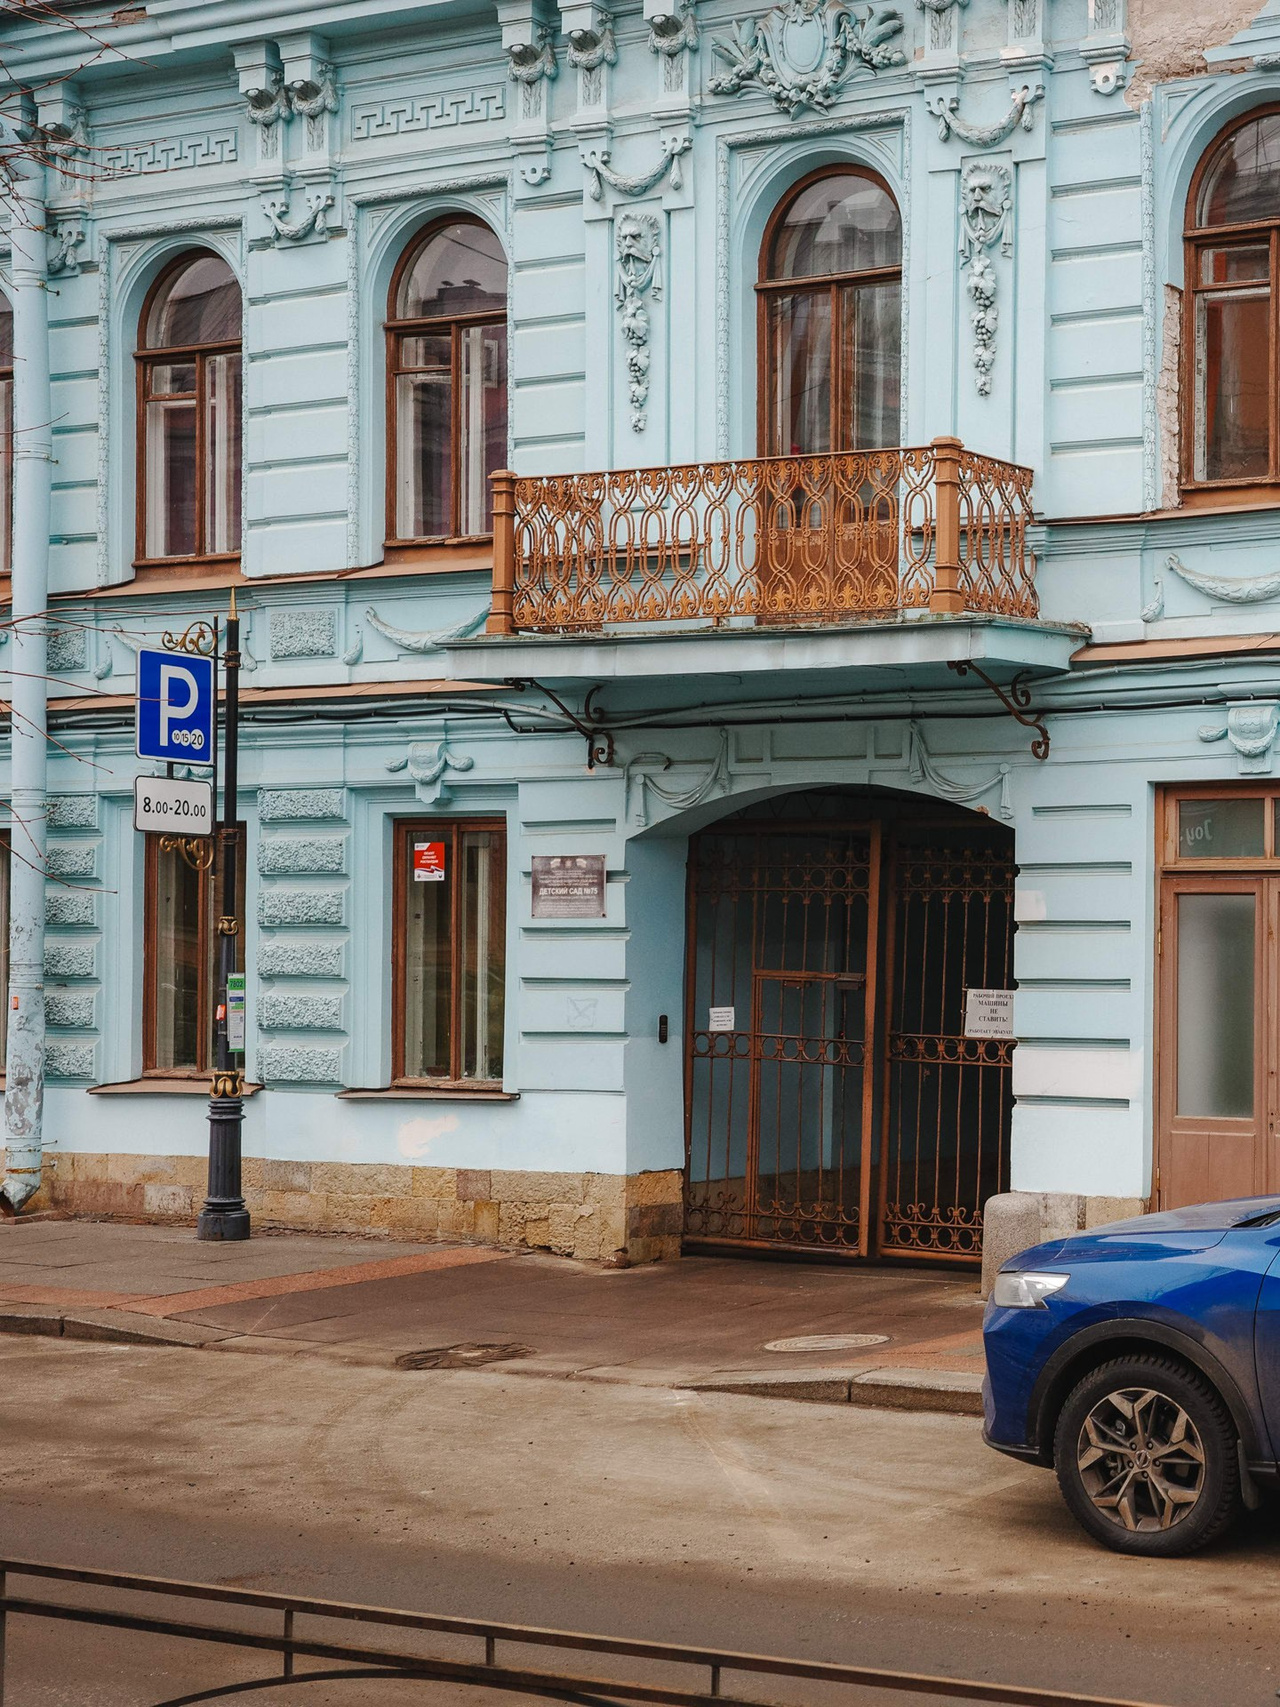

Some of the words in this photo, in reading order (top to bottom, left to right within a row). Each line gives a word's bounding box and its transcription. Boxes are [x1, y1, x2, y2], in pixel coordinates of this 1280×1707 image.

[160, 664, 199, 746] P
[173, 732, 180, 741] 10
[182, 733, 189, 743] 15
[191, 734, 202, 745] 20
[143, 796, 206, 817] 8.00-20.00
[539, 887, 568, 895] ДЕТСКИЙ
[569, 887, 583, 895] САД
[584, 887, 598, 895] №75
[229, 980, 244, 988] 7802
